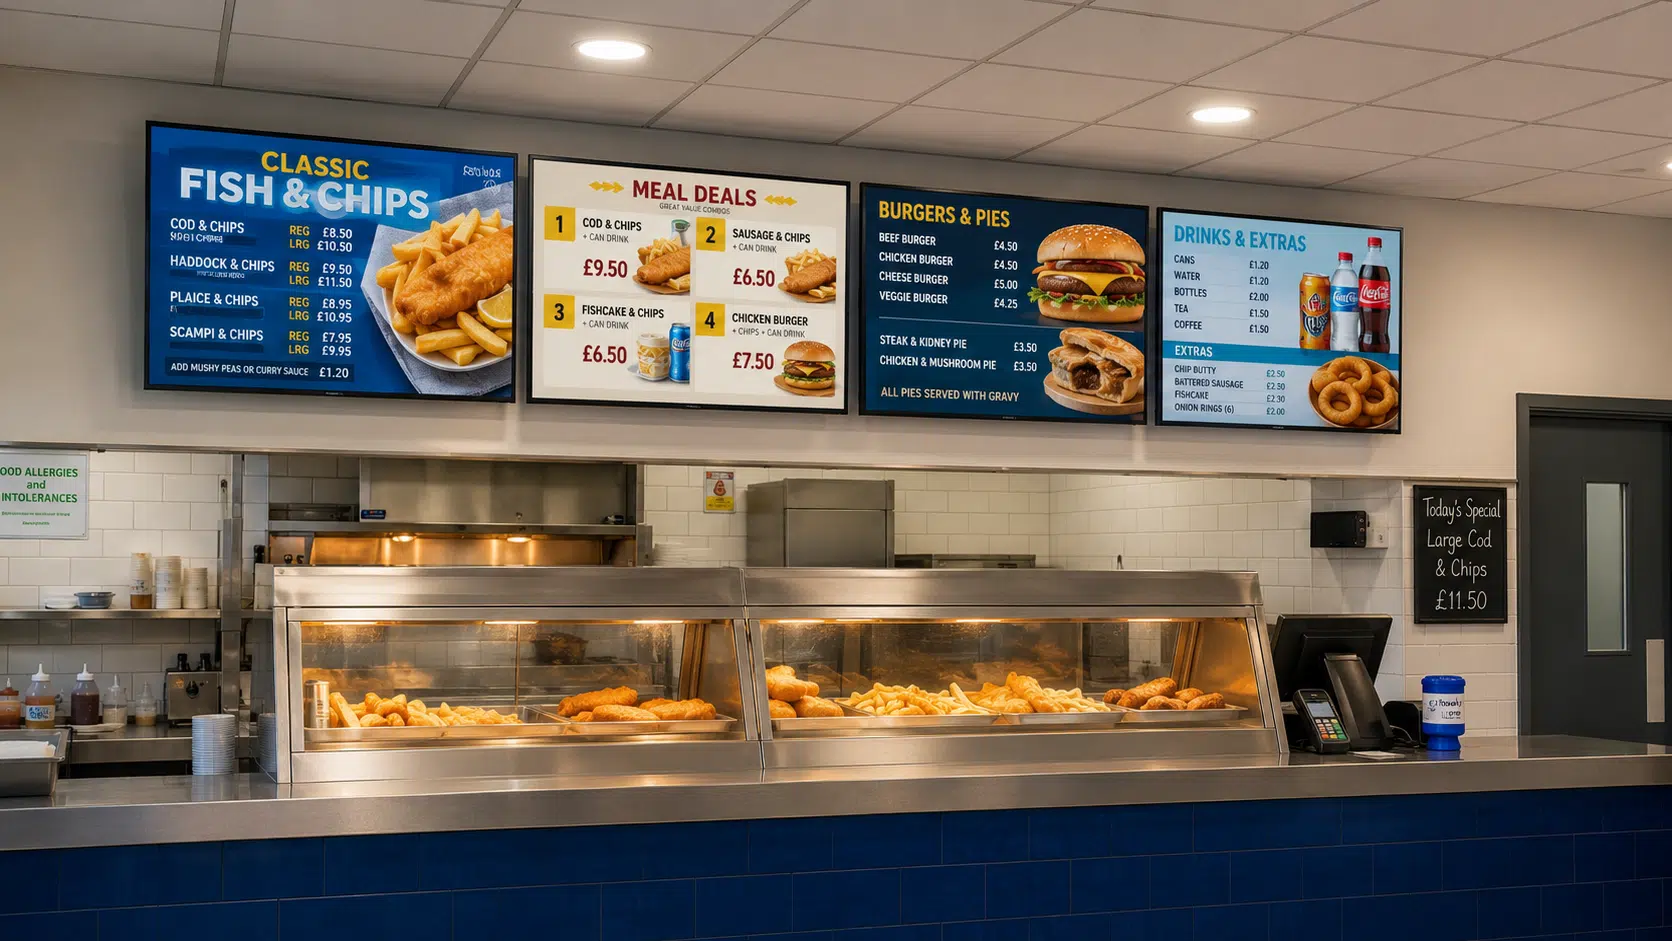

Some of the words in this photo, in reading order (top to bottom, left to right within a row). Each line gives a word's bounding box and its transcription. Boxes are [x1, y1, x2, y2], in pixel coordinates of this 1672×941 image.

[262, 152, 368, 179] CLASSIC
[181, 167, 273, 206] FISH
[283, 178, 309, 208] &
[317, 184, 429, 219] CHIPS
[634, 180, 688, 201] MEAL
[694, 185, 756, 207] DEALS
[880, 201, 955, 223] BURGERS
[960, 209, 971, 224] &
[976, 209, 1010, 227] PIES
[171, 218, 195, 231] COD
[198, 220, 207, 231] &
[210, 221, 244, 233] CHIPS
[556, 216, 562, 232] 1
[583, 218, 602, 228] COD
[605, 220, 612, 229] &
[614, 220, 641, 231] CHIPS
[290, 226, 310, 236] REG
[323, 228, 352, 239] £8.50
[590, 233, 604, 241] CAN
[607, 234, 628, 242] DRINK
[706, 226, 715, 243] 2
[733, 228, 774, 240] SAUSAGE
[776, 232, 782, 241] &
[785, 232, 810, 243] CHIPS
[1175, 225, 1230, 246] DRINKS
[1235, 230, 1245, 247] &
[1250, 232, 1306, 252] EXTRAS
[290, 239, 309, 249] LRG
[318, 241, 352, 252] £10.50
[880, 233, 899, 242] BEEF
[902, 234, 936, 246] BURGER
[994, 241, 1017, 251] £4.50
[739, 243, 753, 251] CAN
[756, 244, 776, 253] DRINK
[171, 255, 227, 269] HADDOCK
[230, 258, 238, 270] &
[242, 260, 274, 272] CHIPS
[879, 252, 916, 263] CHICKEN
[920, 254, 953, 266] BURGER
[994, 260, 1017, 270] £4.50
[1174, 255, 1195, 264] CANS
[1250, 260, 1268, 270] £1.20
[290, 262, 309, 272] REG
[323, 263, 352, 275] £9.50
[584, 259, 627, 278] £9.50
[290, 276, 309, 285] LRG
[318, 277, 352, 287] £11.50
[734, 268, 774, 287] £6.50
[880, 271, 912, 282] CHEESE
[914, 274, 948, 284] BURGER
[1174, 271, 1200, 280] WATER
[1250, 276, 1268, 285] £1.20
[994, 279, 1017, 289] £5.00
[171, 291, 210, 304] PLAICE
[214, 294, 222, 304] &
[226, 294, 258, 306] CHIPS
[880, 291, 911, 301] VEGGIE
[914, 293, 947, 304] BURGER
[1174, 287, 1207, 297] BOTTLES
[1250, 292, 1269, 301] £2.00
[290, 297, 309, 307] REG
[323, 298, 351, 309] £8.95
[994, 298, 1017, 308] £4.25
[1174, 304, 1188, 312] TEA
[290, 311, 309, 320] LRG
[318, 312, 352, 322] £10.95
[554, 304, 564, 320] 3
[583, 305, 626, 316] FISHCAKE
[629, 308, 635, 316] &
[638, 308, 664, 318] CHIPS
[1250, 309, 1268, 318] £1.50
[589, 320, 604, 328] CAN
[607, 321, 628, 329] DRINK
[705, 312, 715, 328] 4
[732, 313, 770, 324] CHICKEN
[774, 316, 808, 326] BURGER
[1174, 320, 1202, 330] COFFEE
[170, 326, 214, 338] SCAMPI
[218, 328, 226, 339] &
[230, 329, 263, 342] CHIPS
[738, 328, 759, 336] CHIPS
[1250, 324, 1268, 333] £1.50
[289, 331, 309, 341] REG
[323, 332, 351, 343] £7.95
[880, 335, 908, 345] STEAK
[911, 337, 916, 346] &
[920, 338, 951, 347] KIDNEY
[954, 339, 966, 348] PIE
[289, 345, 309, 354] LRG
[322, 346, 351, 356] £9.95
[1014, 342, 1037, 352] £3.50
[1176, 345, 1212, 357] EXTRAS
[583, 345, 626, 364] £6.50
[733, 352, 774, 370] £7.50
[880, 355, 918, 366] CHICKEN
[921, 357, 926, 366] &
[930, 358, 980, 368] MUSHROOM
[984, 360, 996, 370] PIE
[1014, 362, 1036, 371] £3.50
[256, 366, 282, 374] CURRY
[284, 367, 308, 376] SAUCE
[320, 367, 348, 378] £1.20
[1175, 365, 1191, 373] CHIP
[1194, 366, 1216, 374] BUTTY
[1175, 378, 1210, 386] BATTERED
[1212, 380, 1243, 388] SAUSAGE
[881, 387, 898, 397] ALL
[902, 388, 921, 398] PIES
[924, 389, 960, 399] SERVED
[963, 391, 986, 400] WITH
[989, 392, 1019, 401] GRAVY
[1175, 390, 1208, 399] FISHCAKE
[1175, 403, 1198, 411] ONION
[1201, 404, 1222, 412] RINGS
[1225, 405, 1234, 414] (6)
[25, 468, 78, 477] ALLERGIES
[27, 480, 46, 489] and
[2, 493, 77, 502] INTOLERANCES
[1423, 497, 1461, 524] Today's
[1466, 498, 1500, 523] Special
[1428, 529, 1462, 554] Large
[1468, 529, 1492, 547] Cod
[1436, 558, 1445, 576] &
[1452, 559, 1486, 583] Chips
[1436, 589, 1486, 610] £11.50
